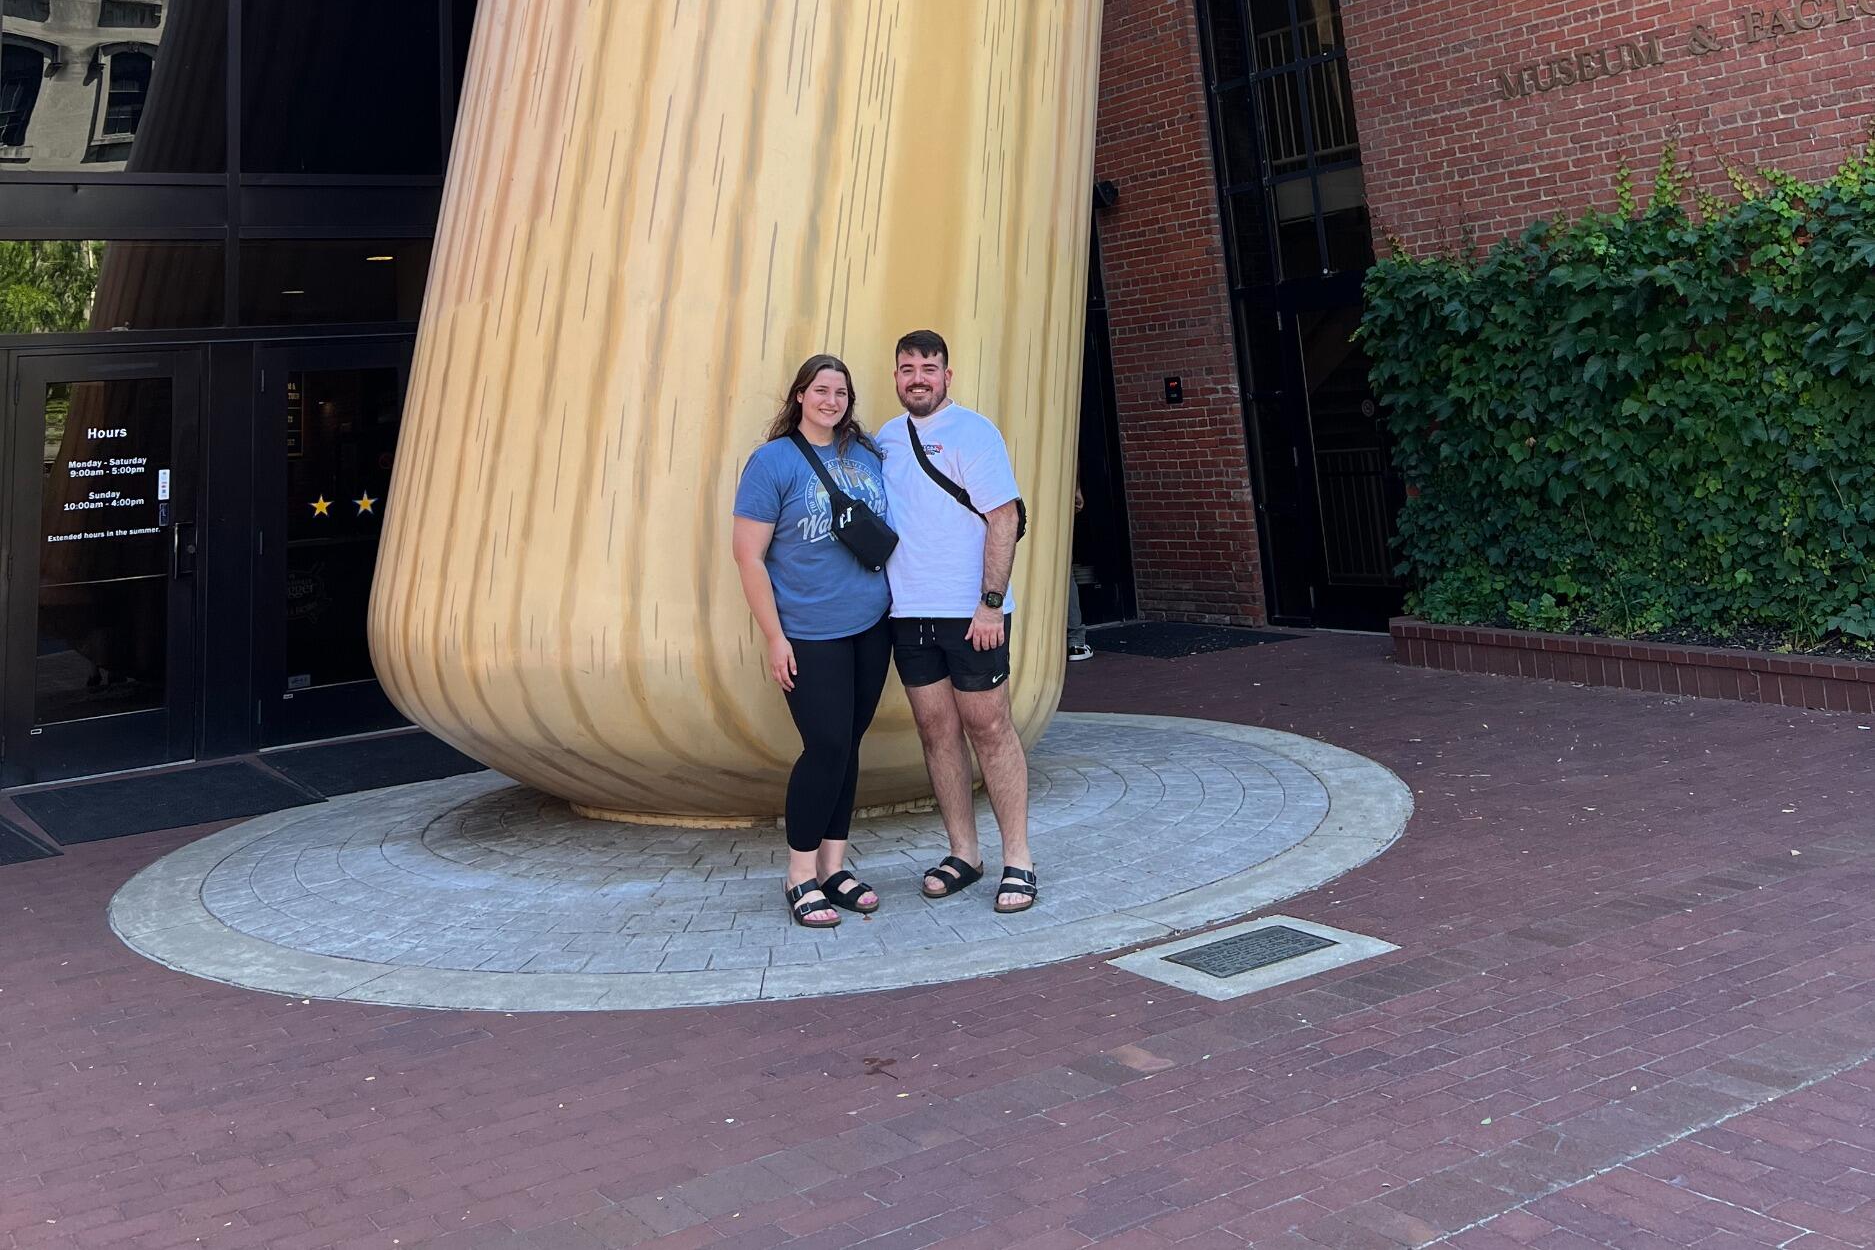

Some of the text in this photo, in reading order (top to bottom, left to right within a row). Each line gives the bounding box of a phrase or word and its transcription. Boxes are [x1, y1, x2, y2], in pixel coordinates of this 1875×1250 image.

[1500, 37, 1665, 100] MUSEUM
[1688, 25, 1723, 55] &
[87, 428, 128, 439] Hours
[68, 460, 102, 469] Monday
[109, 457, 147, 466] Saturday
[70, 469, 104, 478] 9:00am
[111, 466, 145, 475] 5:00pm
[88, 491, 121, 500] Sunday
[63, 501, 103, 511] 10:00am
[111, 498, 144, 507] 4:00pm
[47, 533, 82, 542] Extended
[84, 530, 105, 539] hours
[129, 527, 161, 535] summer.
